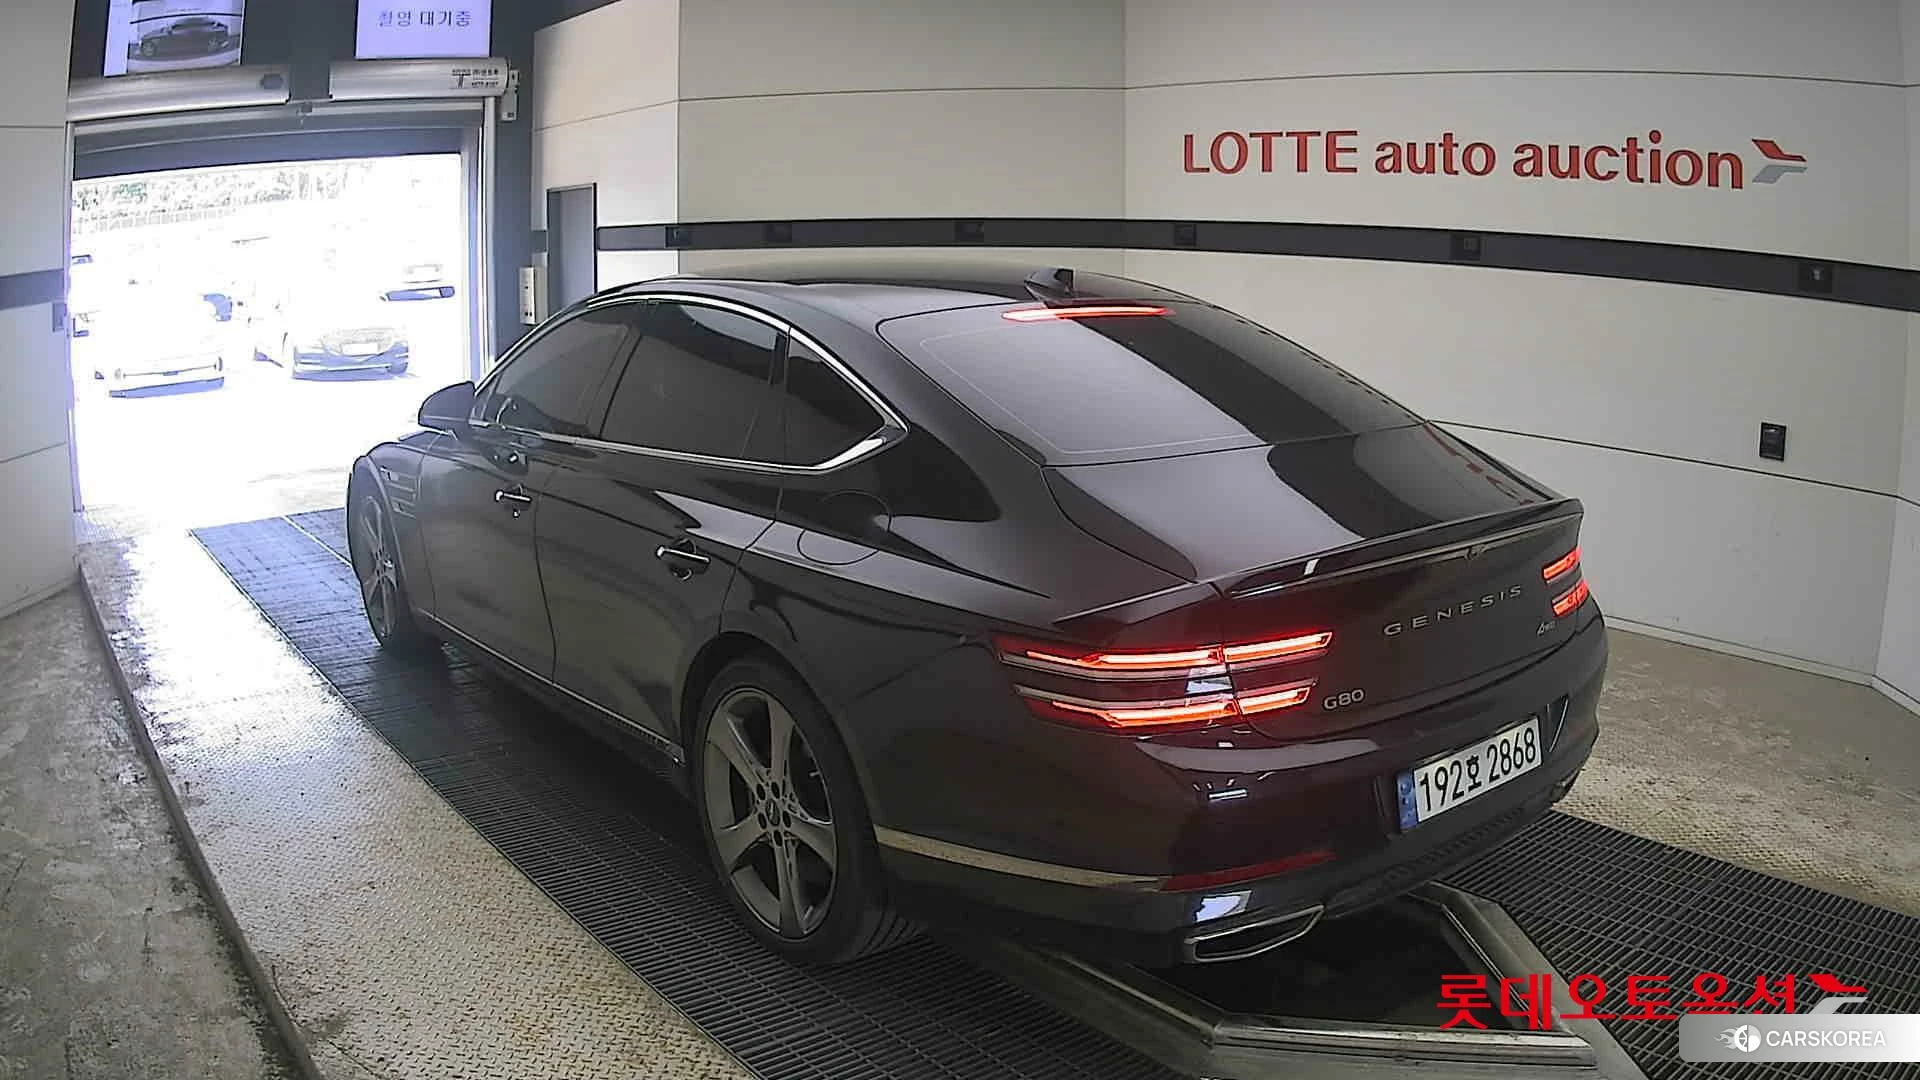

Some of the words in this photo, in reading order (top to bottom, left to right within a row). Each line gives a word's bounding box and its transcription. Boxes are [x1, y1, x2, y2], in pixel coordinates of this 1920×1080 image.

[420, 10, 472, 27] 대기중
[1184, 130, 1358, 174] LOTTE
[1375, 133, 1496, 176] auto
[1513, 130, 1744, 189] auction
[1384, 585, 1521, 635] GENESIS
[1324, 689, 1364, 709] G80
[1487, 727, 1537, 783] 2868
